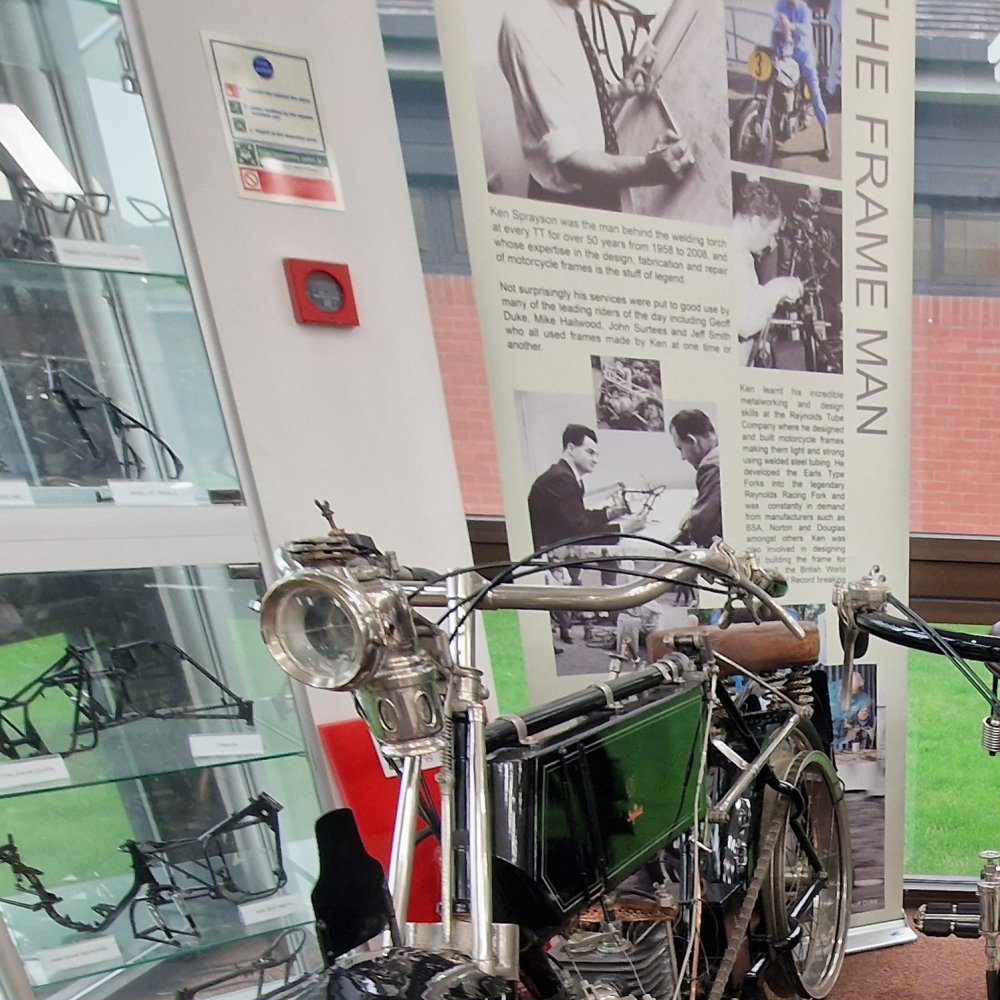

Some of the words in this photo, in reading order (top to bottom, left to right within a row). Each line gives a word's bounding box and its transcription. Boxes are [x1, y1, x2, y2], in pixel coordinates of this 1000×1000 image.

[856, 0, 889, 94] HE
[490, 206, 510, 219] Ken
[512, 209, 558, 226] Sprayson
[560, 219, 579, 229] was
[582, 219, 596, 231] the
[599, 224, 620, 234] man
[622, 224, 653, 238] behind
[656, 229, 669, 241] the
[672, 232, 704, 248] welding
[707, 235, 726, 248] torch
[856, 114, 888, 308] FRAME
[493, 222, 502, 233] at
[504, 226, 530, 240] every
[533, 227, 545, 238] TT
[548, 229, 560, 240] for
[564, 234, 584, 243] over
[587, 234, 598, 245] 50
[602, 238, 626, 249] years
[629, 239, 649, 252] from
[676, 245, 684, 256] to
[713, 251, 728, 262] and
[495, 238, 525, 251] whose
[528, 244, 571, 256] expertise
[574, 246, 582, 258] in
[585, 248, 600, 260] the
[639, 254, 684, 270] fabrication
[687, 262, 702, 272] and
[705, 265, 727, 277] repair
[496, 252, 505, 262] of
[508, 254, 558, 270] motorcycle
[561, 259, 593, 273] frames
[595, 263, 603, 274] is
[606, 265, 620, 276] the
[623, 267, 642, 279] stuff
[644, 270, 652, 280] of
[500, 281, 516, 293] Not
[519, 286, 571, 302] surprisingly
[574, 289, 587, 301] his
[590, 293, 627, 305] services
[630, 298, 651, 307] were
[654, 298, 667, 311] put
[670, 299, 678, 310] to
[681, 302, 701, 314] good
[704, 305, 718, 314] use
[720, 304, 729, 318] by
[502, 298, 527, 311] many
[530, 299, 539, 310] of
[542, 300, 556, 311] the
[559, 301, 592, 318] leading
[595, 305, 620, 318] riders
[623, 308, 632, 319] of
[635, 309, 648, 320] the
[652, 310, 666, 325] day
[670, 312, 707, 329] including
[506, 325, 525, 336] who
[529, 327, 539, 337] all
[544, 329, 566, 340] used
[570, 330, 601, 343] frames
[606, 334, 630, 346] made
[635, 336, 645, 350] by
[650, 337, 667, 348] Ken
[672, 339, 680, 350] at
[684, 342, 699, 351] one
[703, 341, 720, 353] time
[724, 346, 731, 354] or
[534, 313, 556, 325] Mike
[610, 320, 630, 332] John
[634, 322, 667, 335] Surtees
[671, 326, 687, 337] and
[692, 327, 705, 339] Jeff
[709, 329, 731, 341] Smith
[856, 328, 888, 436] MAN
[745, 491, 778, 500] Reynolds
[782, 491, 807, 501] Racing
[810, 481, 845, 491] legendary
